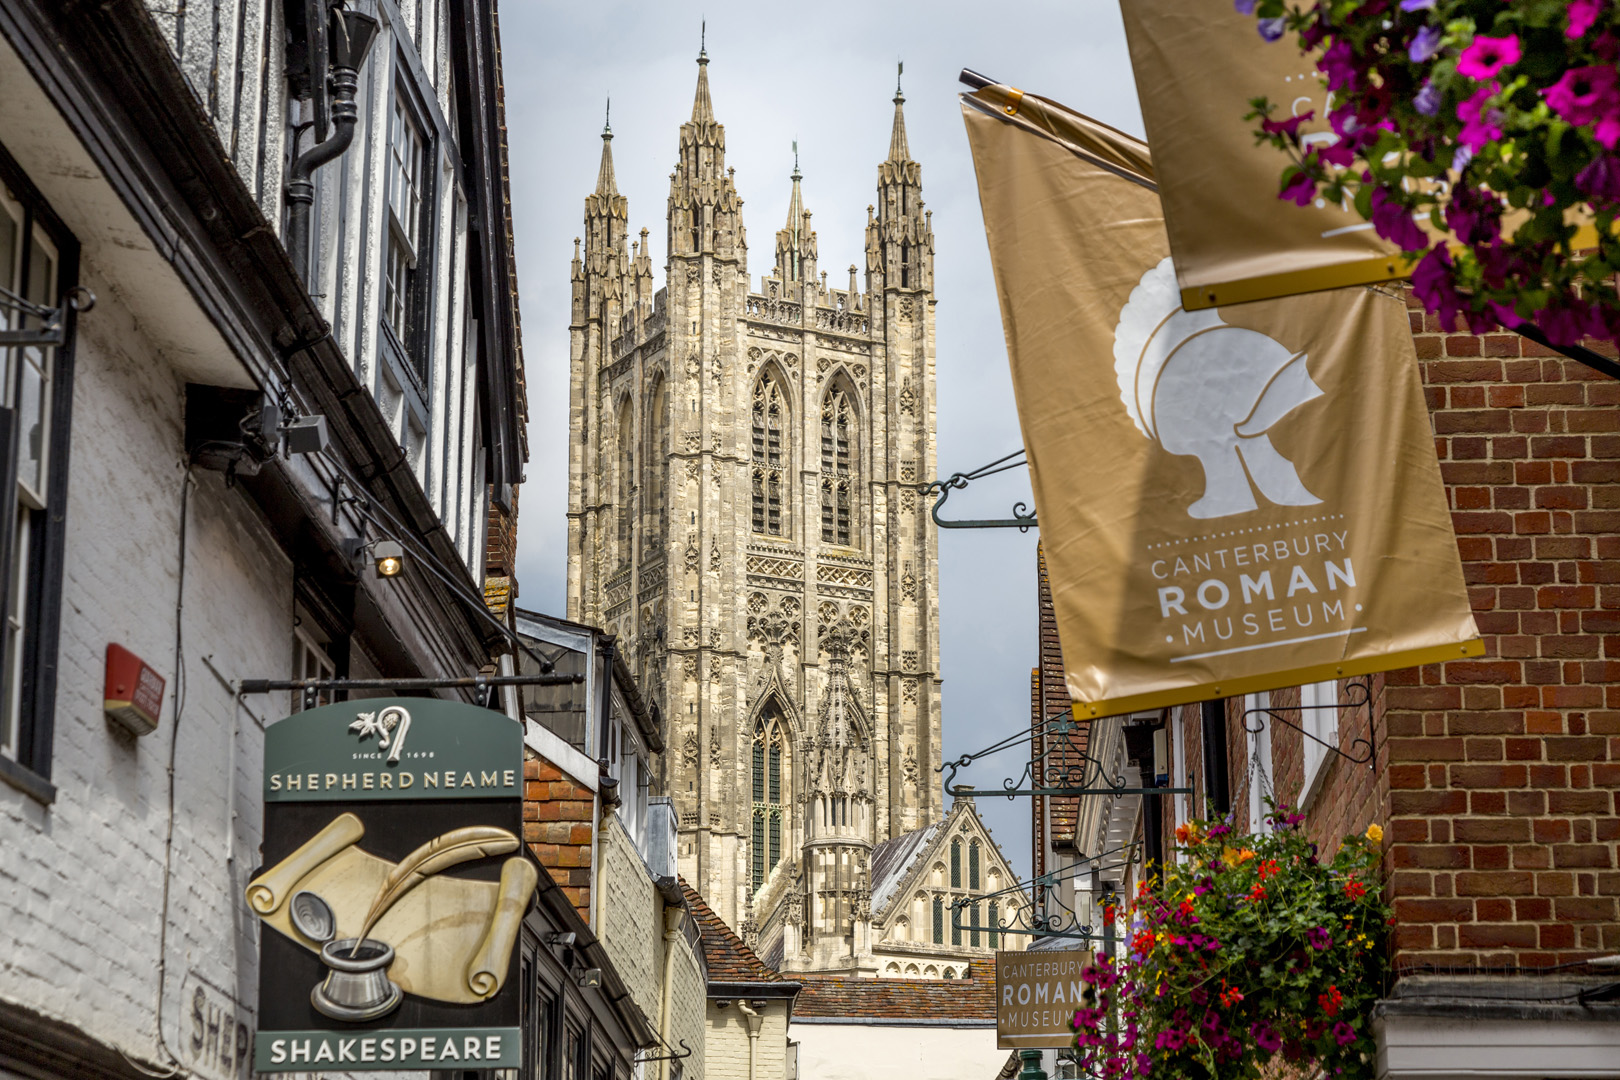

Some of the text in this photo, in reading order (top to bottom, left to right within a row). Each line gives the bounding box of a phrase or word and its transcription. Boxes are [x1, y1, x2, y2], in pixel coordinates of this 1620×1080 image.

[1151, 530, 1348, 580] CANTERBURY
[1157, 557, 1357, 618] ROMAN
[1182, 599, 1345, 646] MUSEUM
[352, 751, 435, 760] SINCE 1698
[270, 769, 516, 791] SHEPHERD NEAME
[1003, 961, 1084, 979] CANTERBURY
[1002, 980, 1082, 1006] ROMAN
[270, 1036, 502, 1064] SHAKESPEARE
